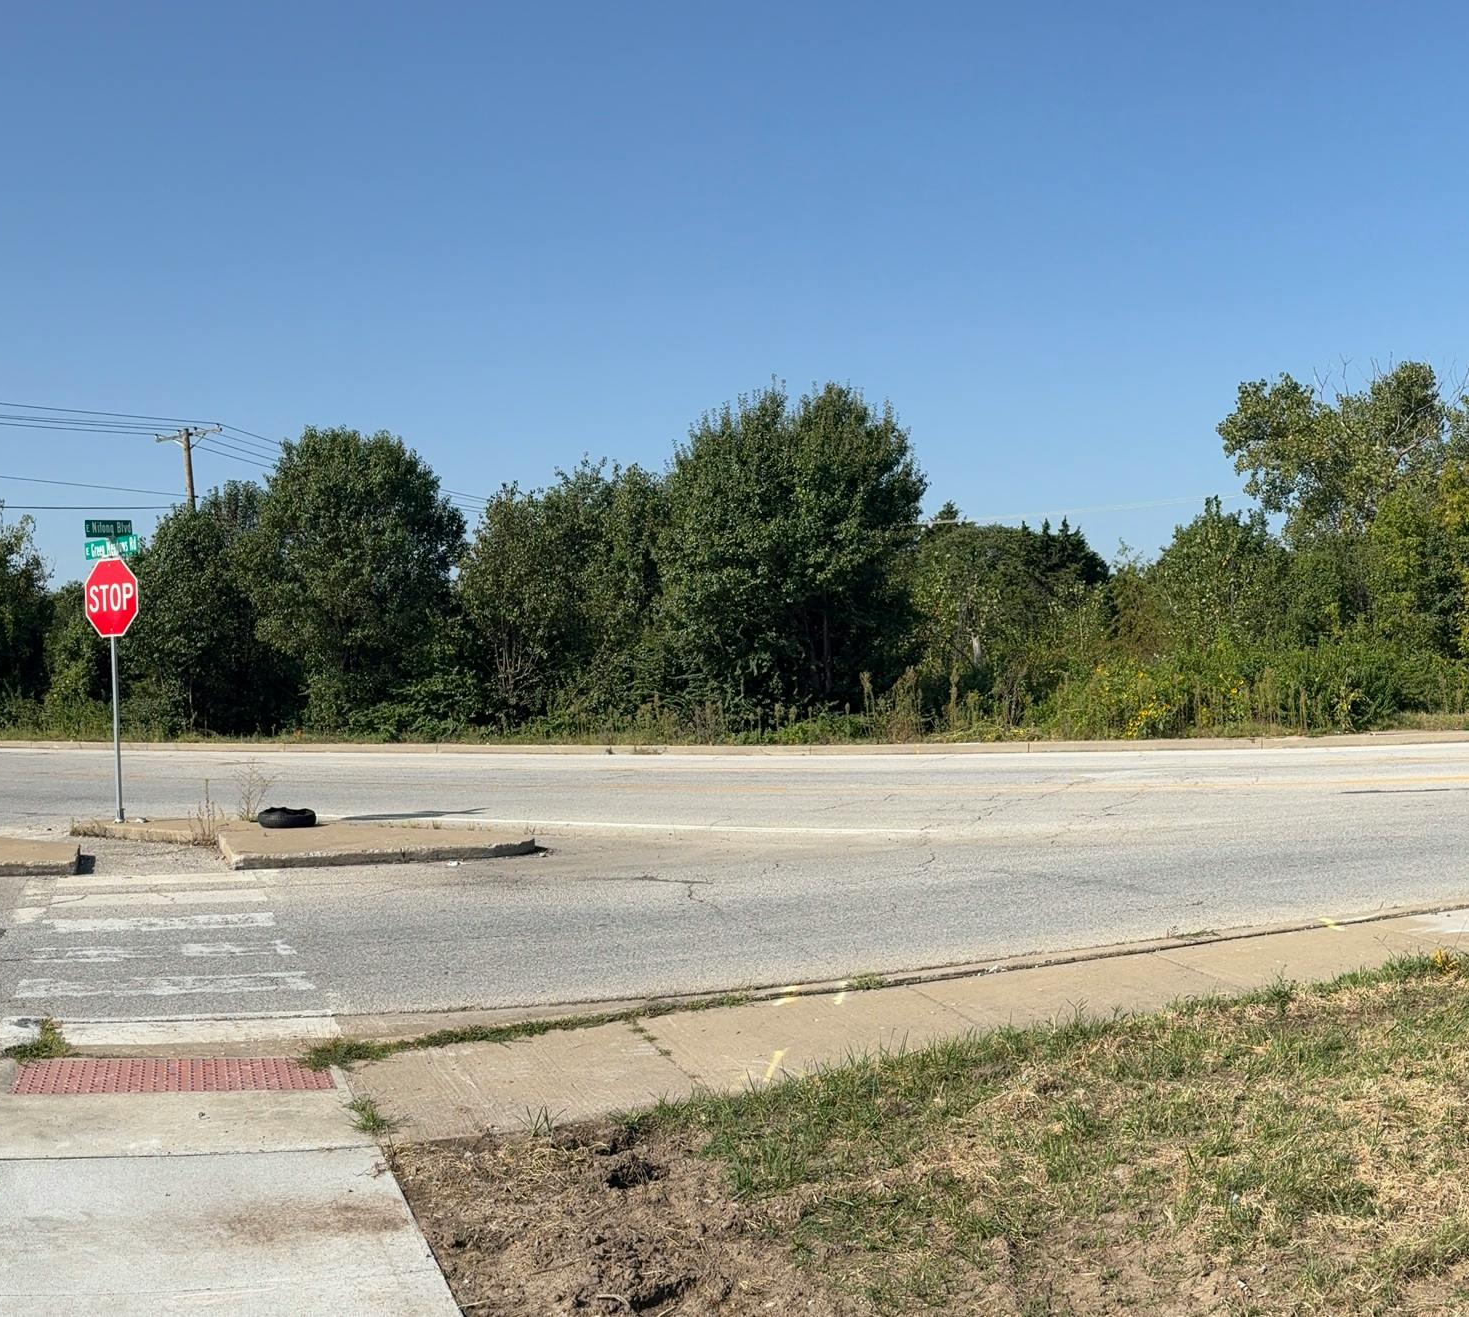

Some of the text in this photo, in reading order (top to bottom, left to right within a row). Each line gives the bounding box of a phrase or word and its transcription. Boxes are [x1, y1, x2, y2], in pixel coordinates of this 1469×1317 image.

[85, 524, 90, 533] E
[116, 521, 132, 533] Blvd
[85, 547, 90, 556] E
[90, 543, 105, 558] Green
[89, 582, 134, 613] STOP
